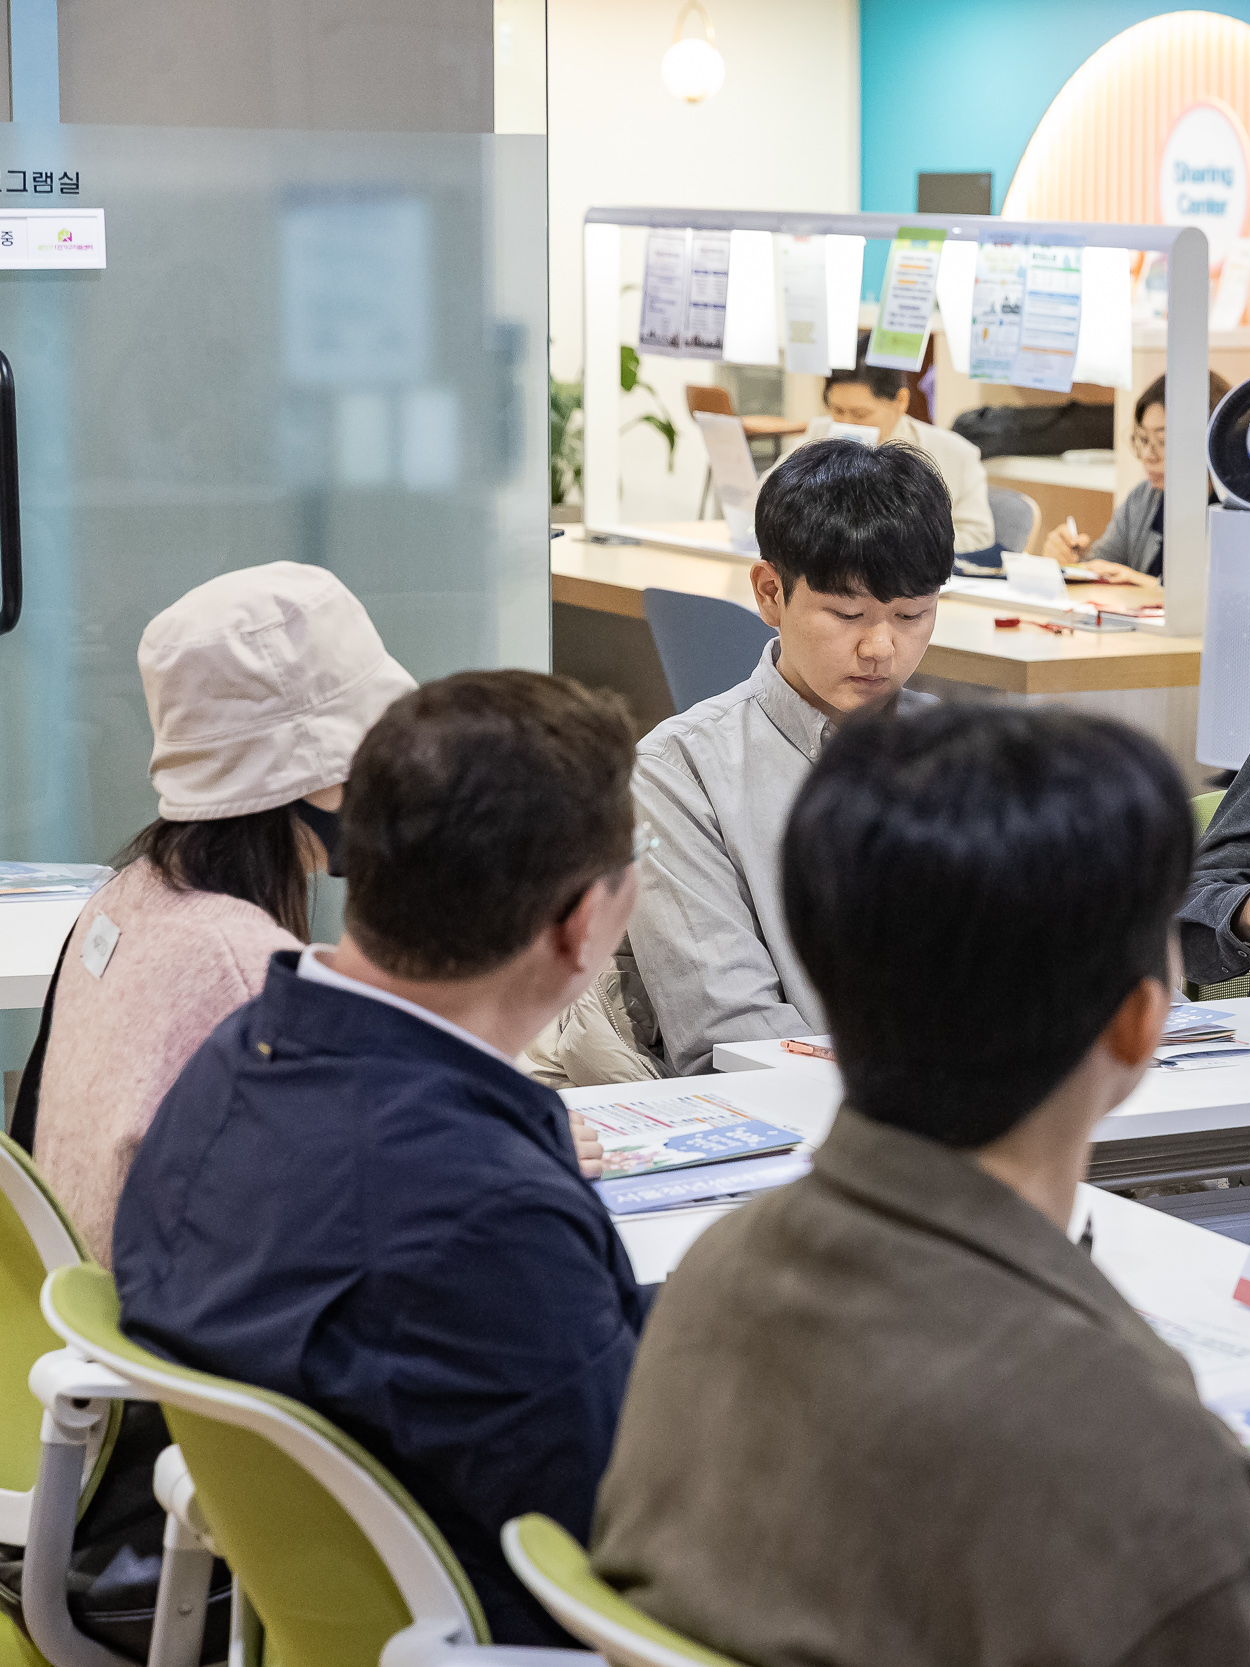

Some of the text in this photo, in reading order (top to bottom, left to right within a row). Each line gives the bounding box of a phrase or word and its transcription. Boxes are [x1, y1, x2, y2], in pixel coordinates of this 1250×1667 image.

[0, 170, 80, 195] 그램실
[1174, 161, 1234, 187] Sharing
[1177, 195, 1227, 215] Center
